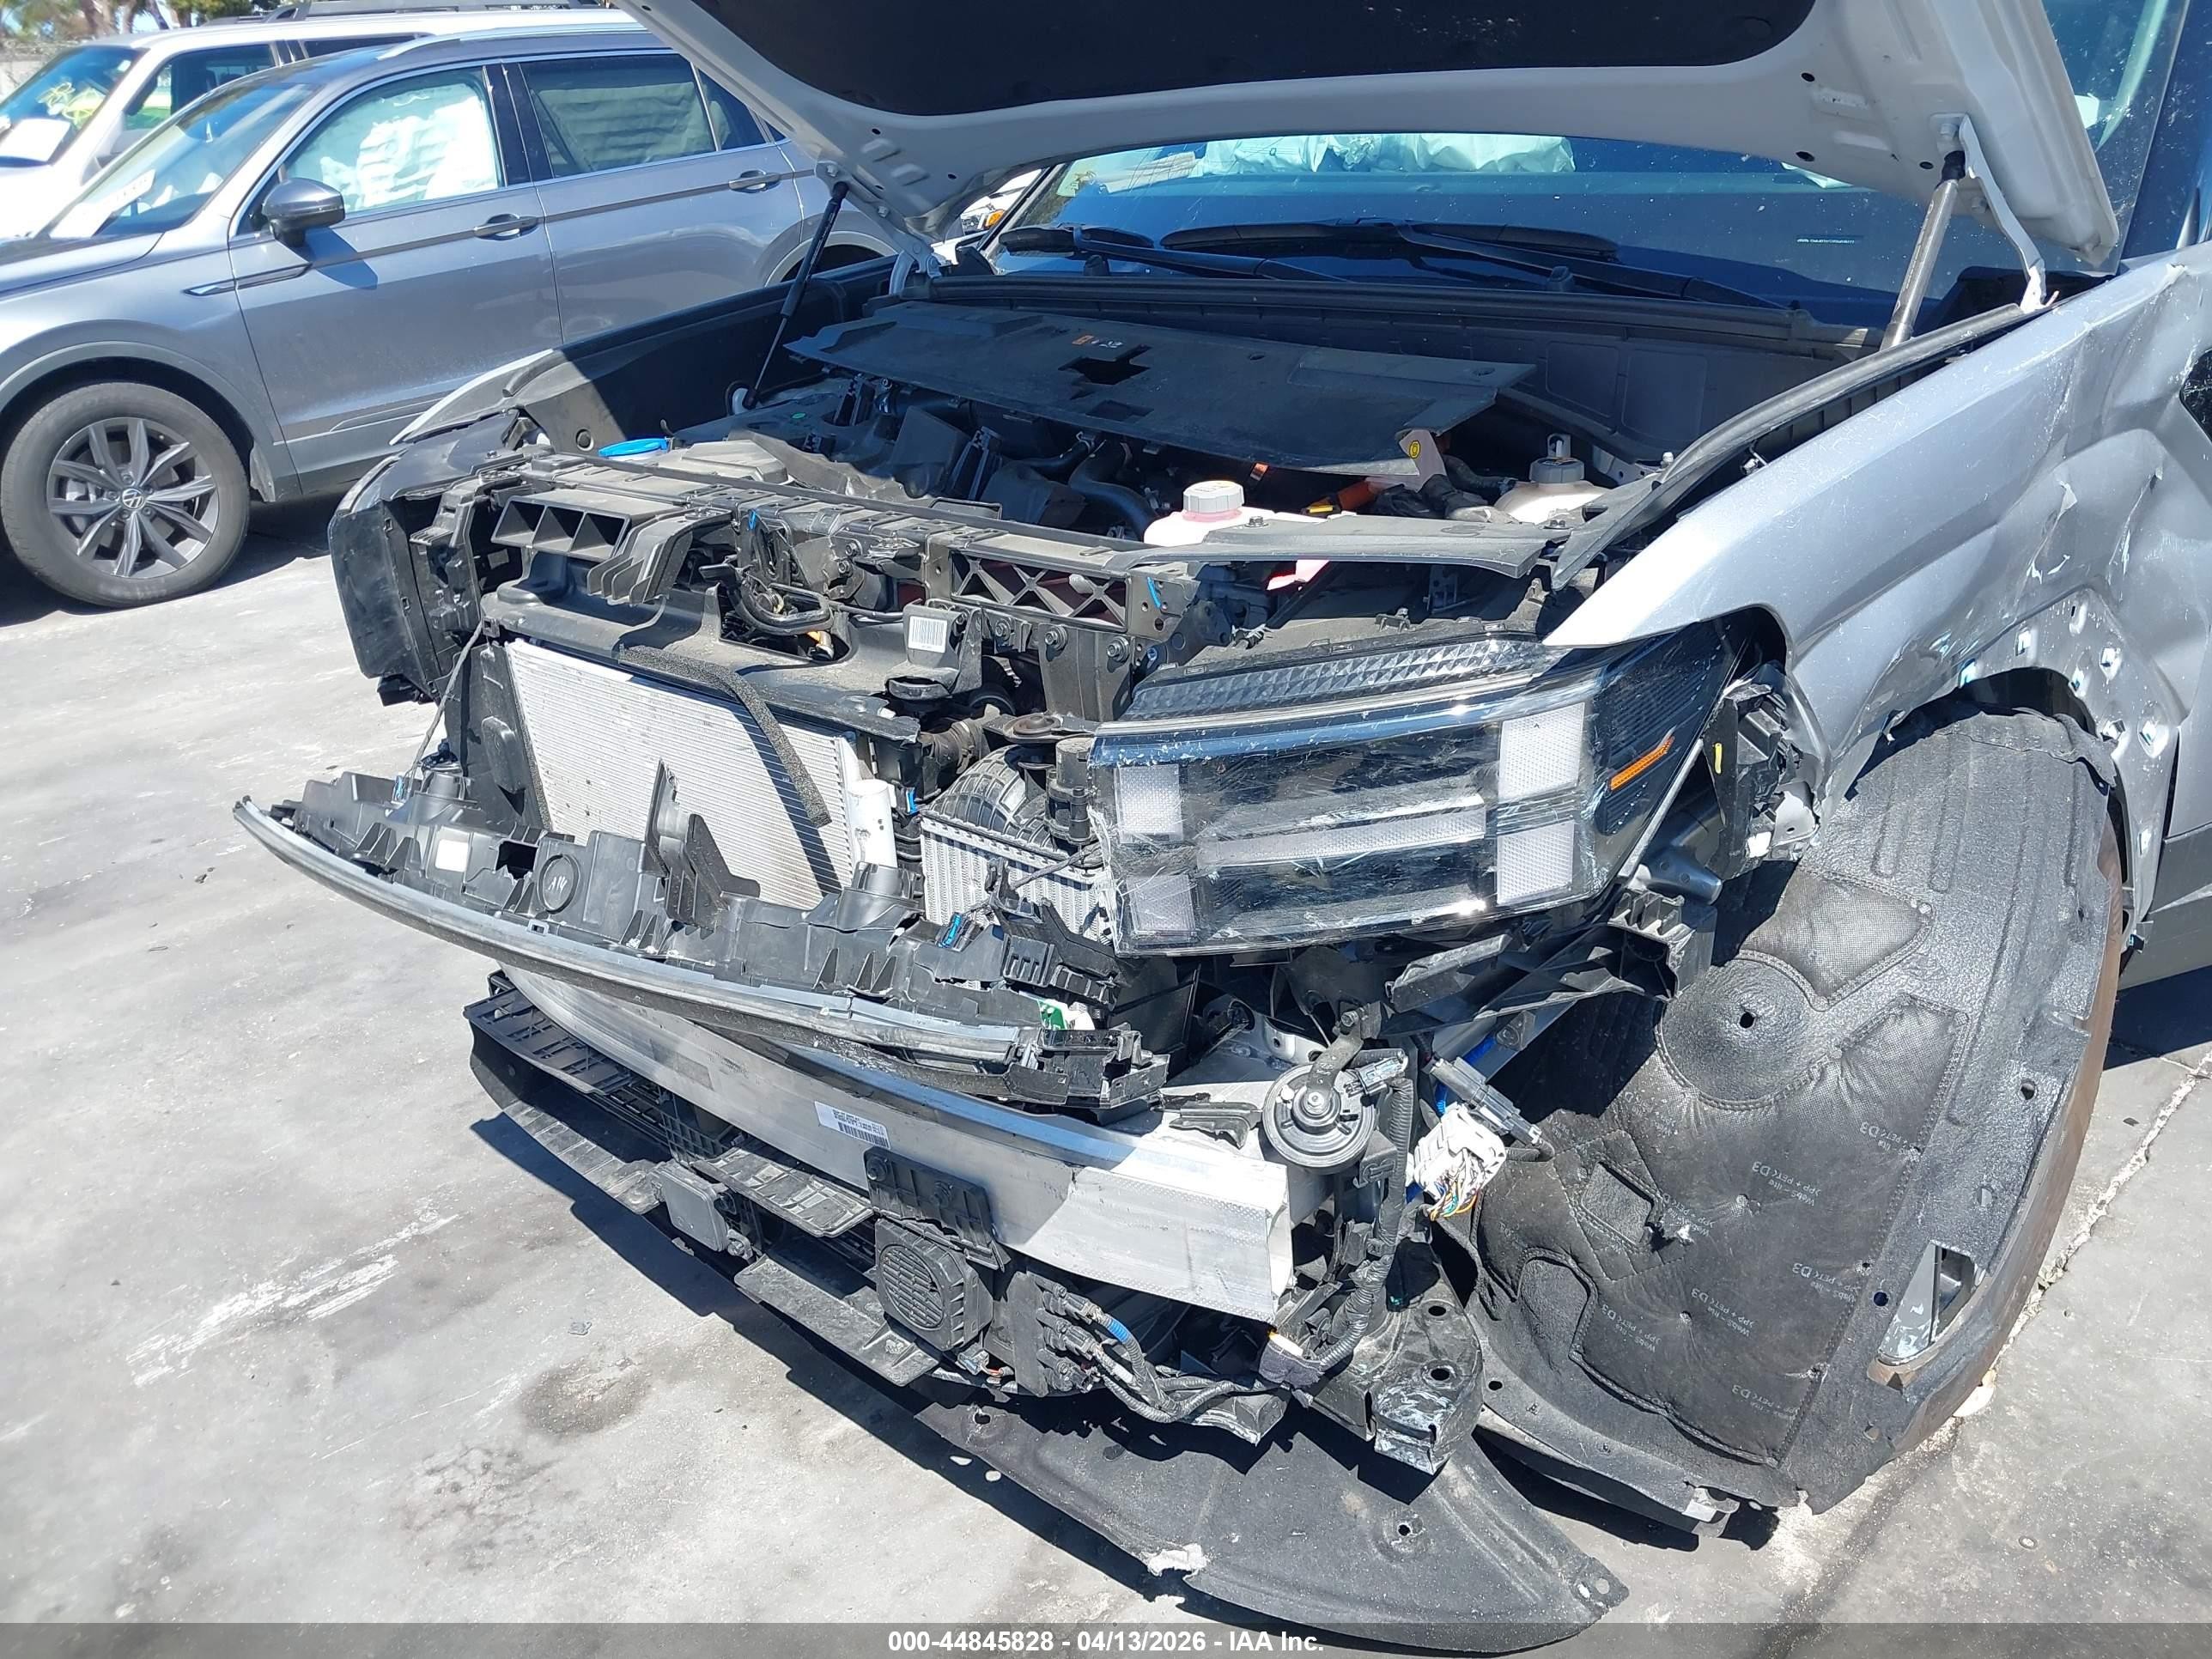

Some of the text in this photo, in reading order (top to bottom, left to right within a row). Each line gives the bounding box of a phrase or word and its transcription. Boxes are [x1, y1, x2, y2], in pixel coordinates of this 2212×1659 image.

[1860, 1121, 1880, 1139] D3
[1752, 1161, 1771, 1176] D3
[1792, 1262, 1813, 1278] D3
[1691, 1288, 1709, 1304] D3
[1602, 1304, 1616, 1321] D3
[1732, 1384, 1751, 1399] D3
